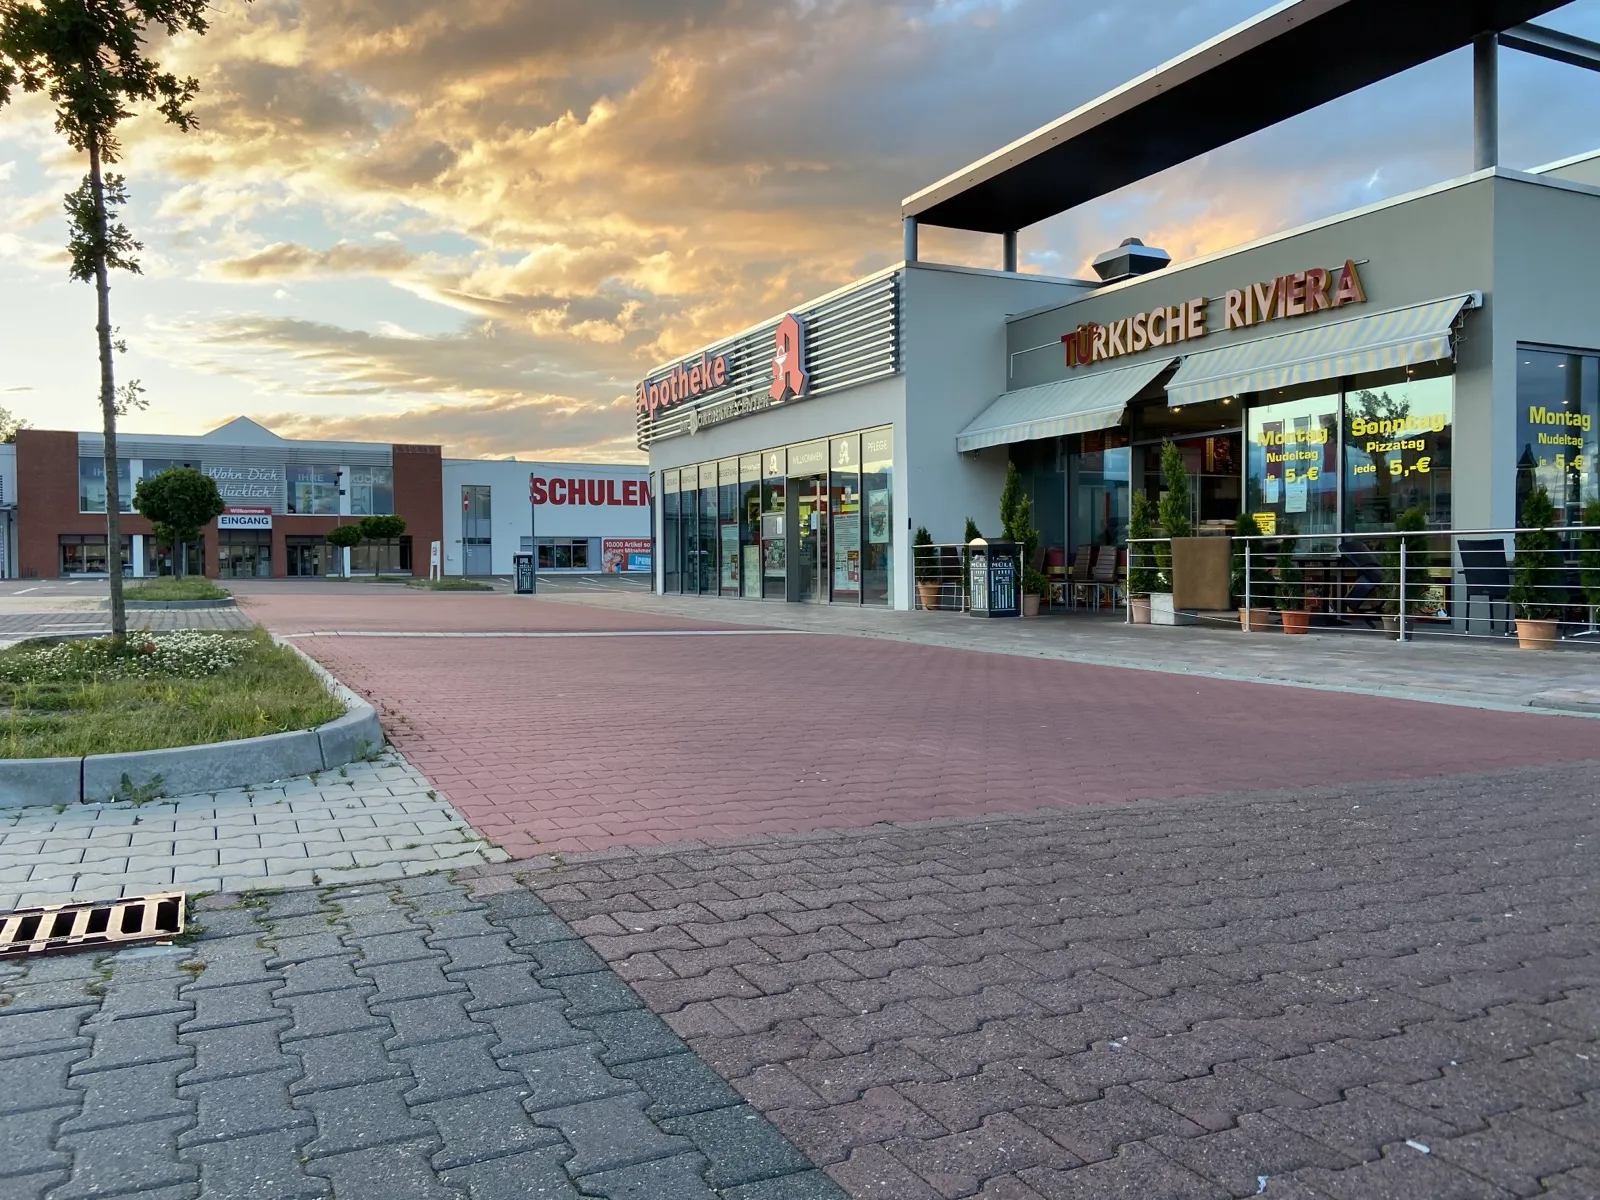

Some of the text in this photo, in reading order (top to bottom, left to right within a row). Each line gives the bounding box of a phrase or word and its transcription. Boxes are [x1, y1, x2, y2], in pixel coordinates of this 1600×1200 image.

[1061, 260, 1367, 366] TÜRKISCHE RIVIERA
[638, 351, 729, 420] Apotheke
[1351, 412, 1445, 436] Sonntag
[1529, 405, 1591, 431] Montag
[1257, 428, 1328, 447] Montag
[1366, 439, 1425, 453] Pizzatag
[1538, 432, 1584, 449] Nudeltag
[1266, 450, 1319, 463] Nudeltag
[1539, 455, 1547, 467] je
[208, 467, 279, 480] Wohn Dich
[1353, 463, 1377, 475] jede
[529, 477, 651, 506] SCHULEN
[221, 516, 269, 525] EINGANG
